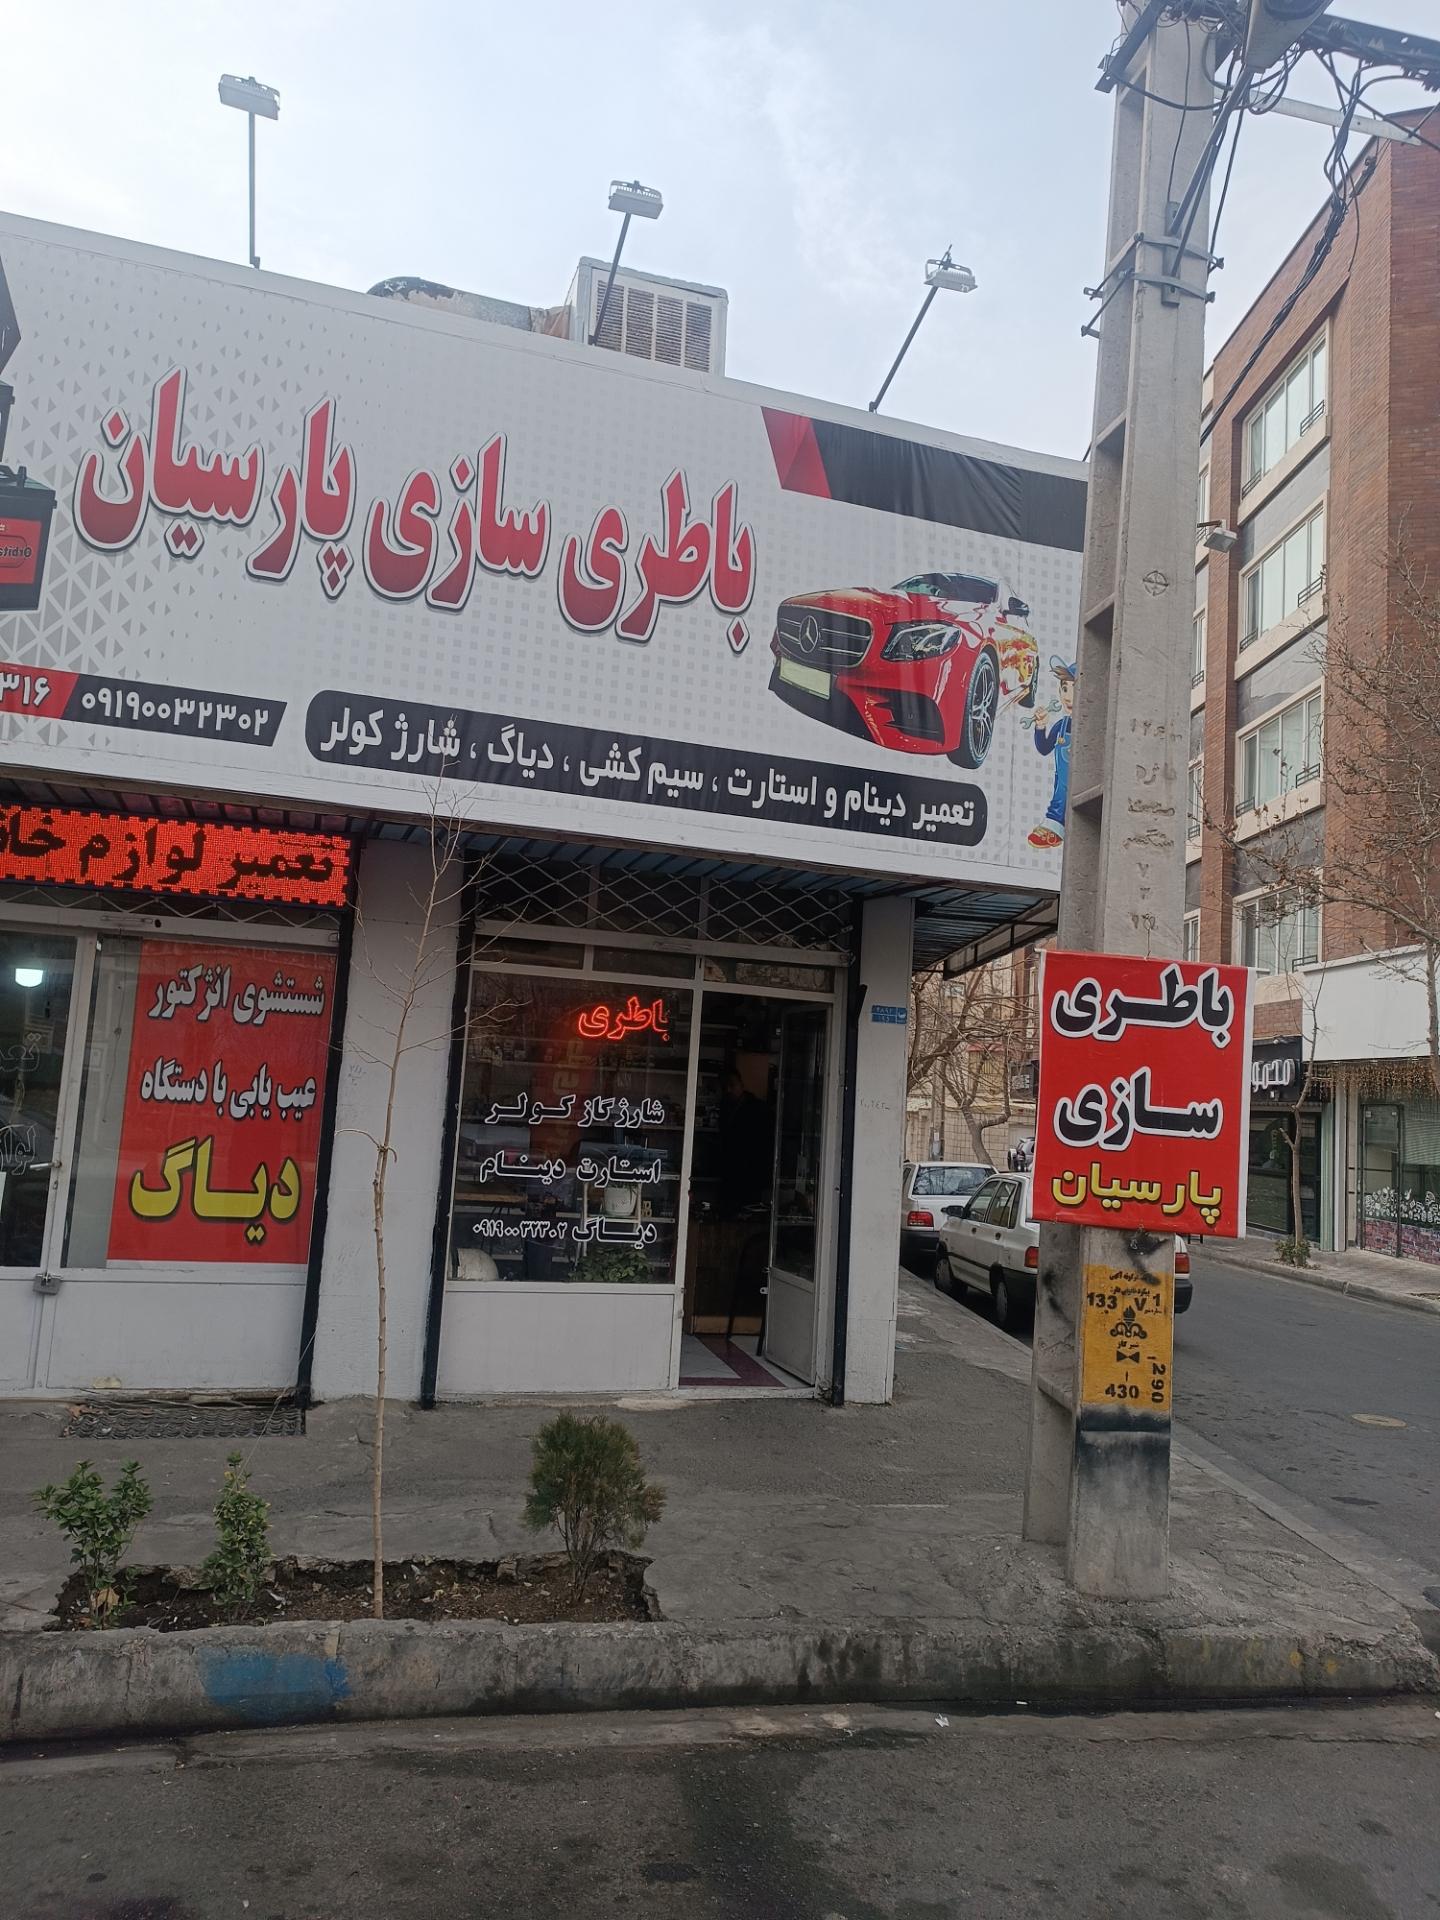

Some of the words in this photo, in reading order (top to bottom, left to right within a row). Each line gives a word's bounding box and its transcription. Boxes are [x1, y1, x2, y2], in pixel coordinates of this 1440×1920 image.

[73, 364, 356, 599] پارسیان
[362, 431, 551, 611] سازی
[558, 466, 756, 653] باطری
[81, 687, 269, 736] ۰۹۱۹۰۰۳۲۳۰۲
[319, 706, 385, 756] کولر
[390, 711, 461, 764] شارژ
[487, 723, 554, 779] دیاگ
[579, 742, 643, 788] کشی
[647, 761, 705, 798] سیم
[728, 768, 818, 809] استارت
[824, 787, 838, 818] و
[843, 781, 907, 826] دینام
[912, 800, 976, 833] تعمیر
[79, 822, 207, 886] لوازم
[233, 970, 325, 1026] شستشوی
[577, 996, 669, 1042] باطری
[1051, 963, 1235, 1049] باطری
[140, 1056, 208, 1104] دستگاه
[211, 1059, 228, 1117] با
[229, 1063, 272, 1120] یابی
[276, 1076, 317, 1121] عیب
[485, 1093, 577, 1125] کولر
[577, 1096, 616, 1128] گاز
[615, 1097, 665, 1129] شارژ
[1053, 1066, 1224, 1151] سازی
[129, 1134, 302, 1246] دیاگ
[479, 1150, 566, 1185] دینام
[576, 1155, 662, 1188] استارت
[1051, 1162, 1223, 1226] پارسیان
[572, 1215, 658, 1250] دیاگ
[1087, 1292, 1118, 1310] 133
[1104, 1383, 1140, 1399] 430
[1151, 1362, 1166, 1404] 290
